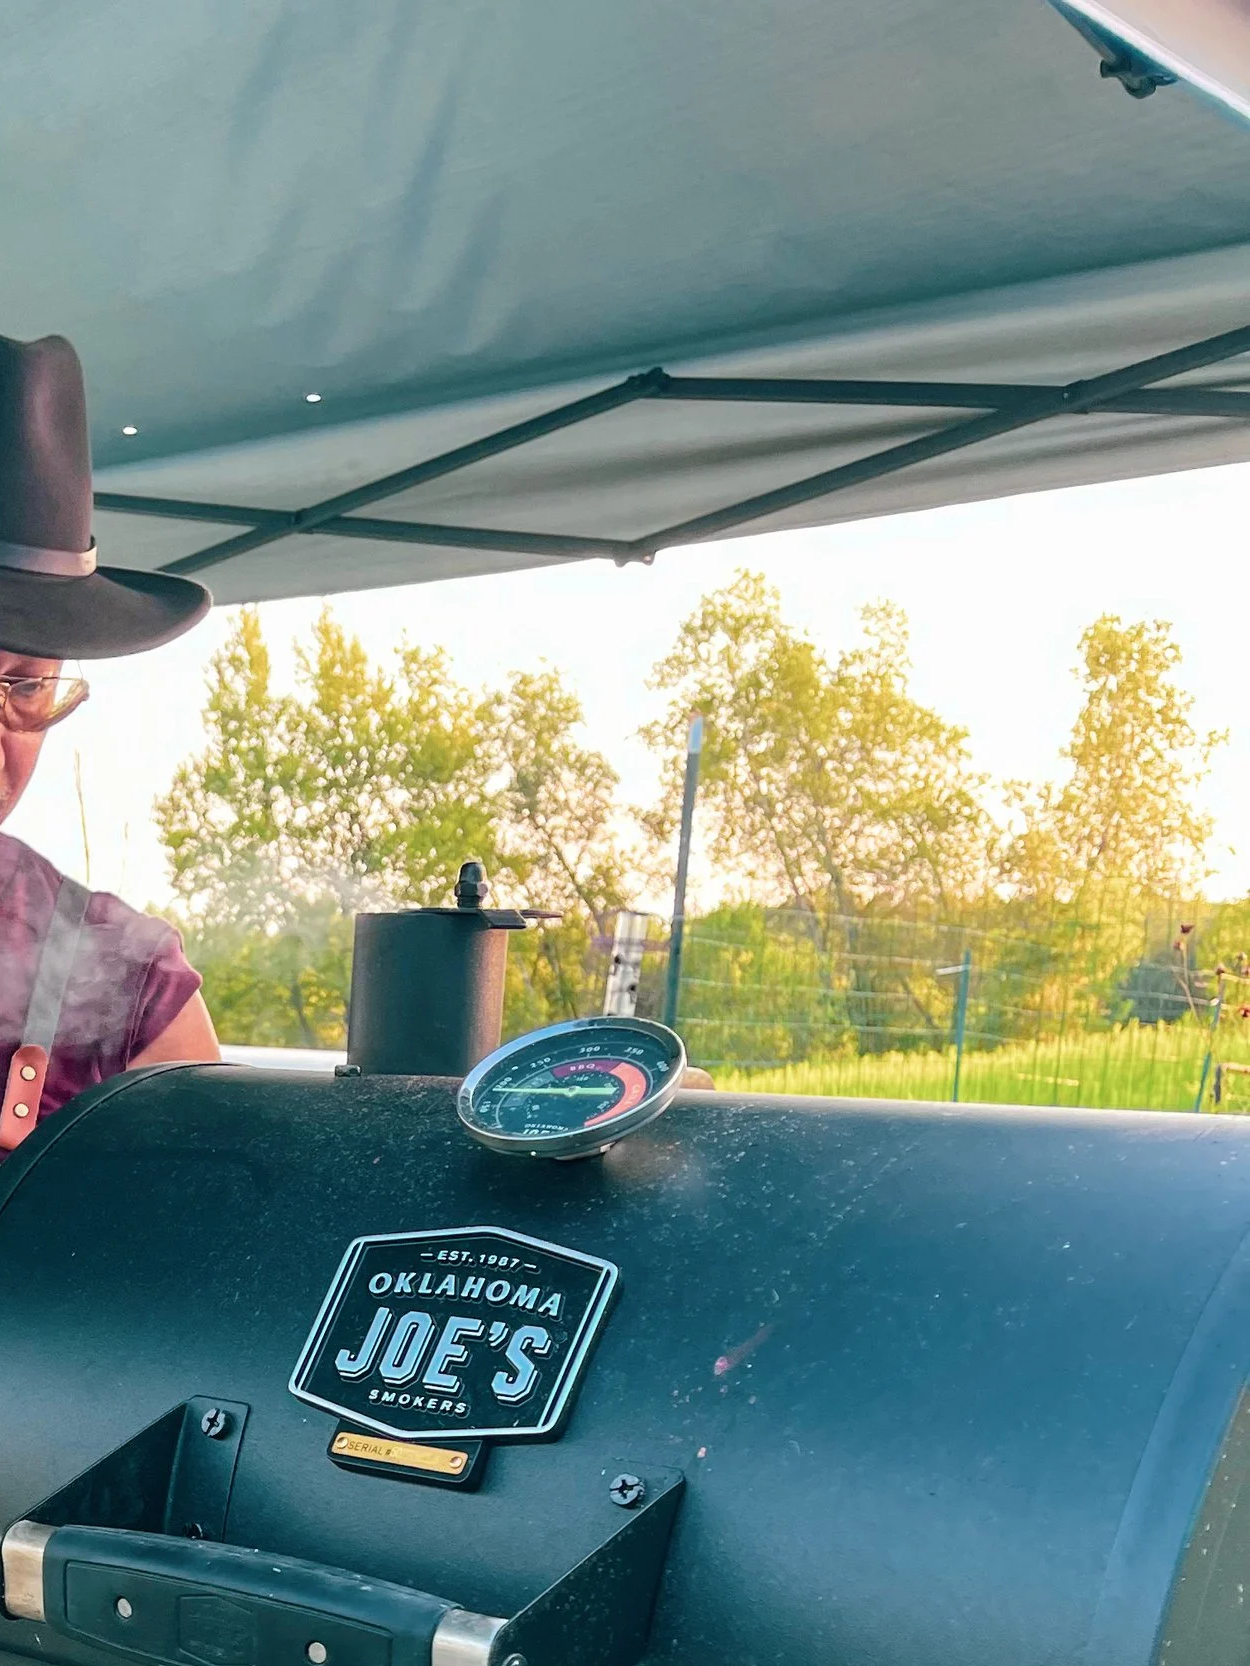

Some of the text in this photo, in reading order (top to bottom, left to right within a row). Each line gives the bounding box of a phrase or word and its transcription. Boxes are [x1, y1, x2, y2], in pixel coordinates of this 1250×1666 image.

[437, 1249, 520, 1268] EST. 1987
[367, 1271, 562, 1317] OKLAHOMA
[334, 1306, 551, 1403] JOE'S
[368, 1389, 467, 1414] SMOKERS
[347, 1441, 383, 1456] SERIAL
